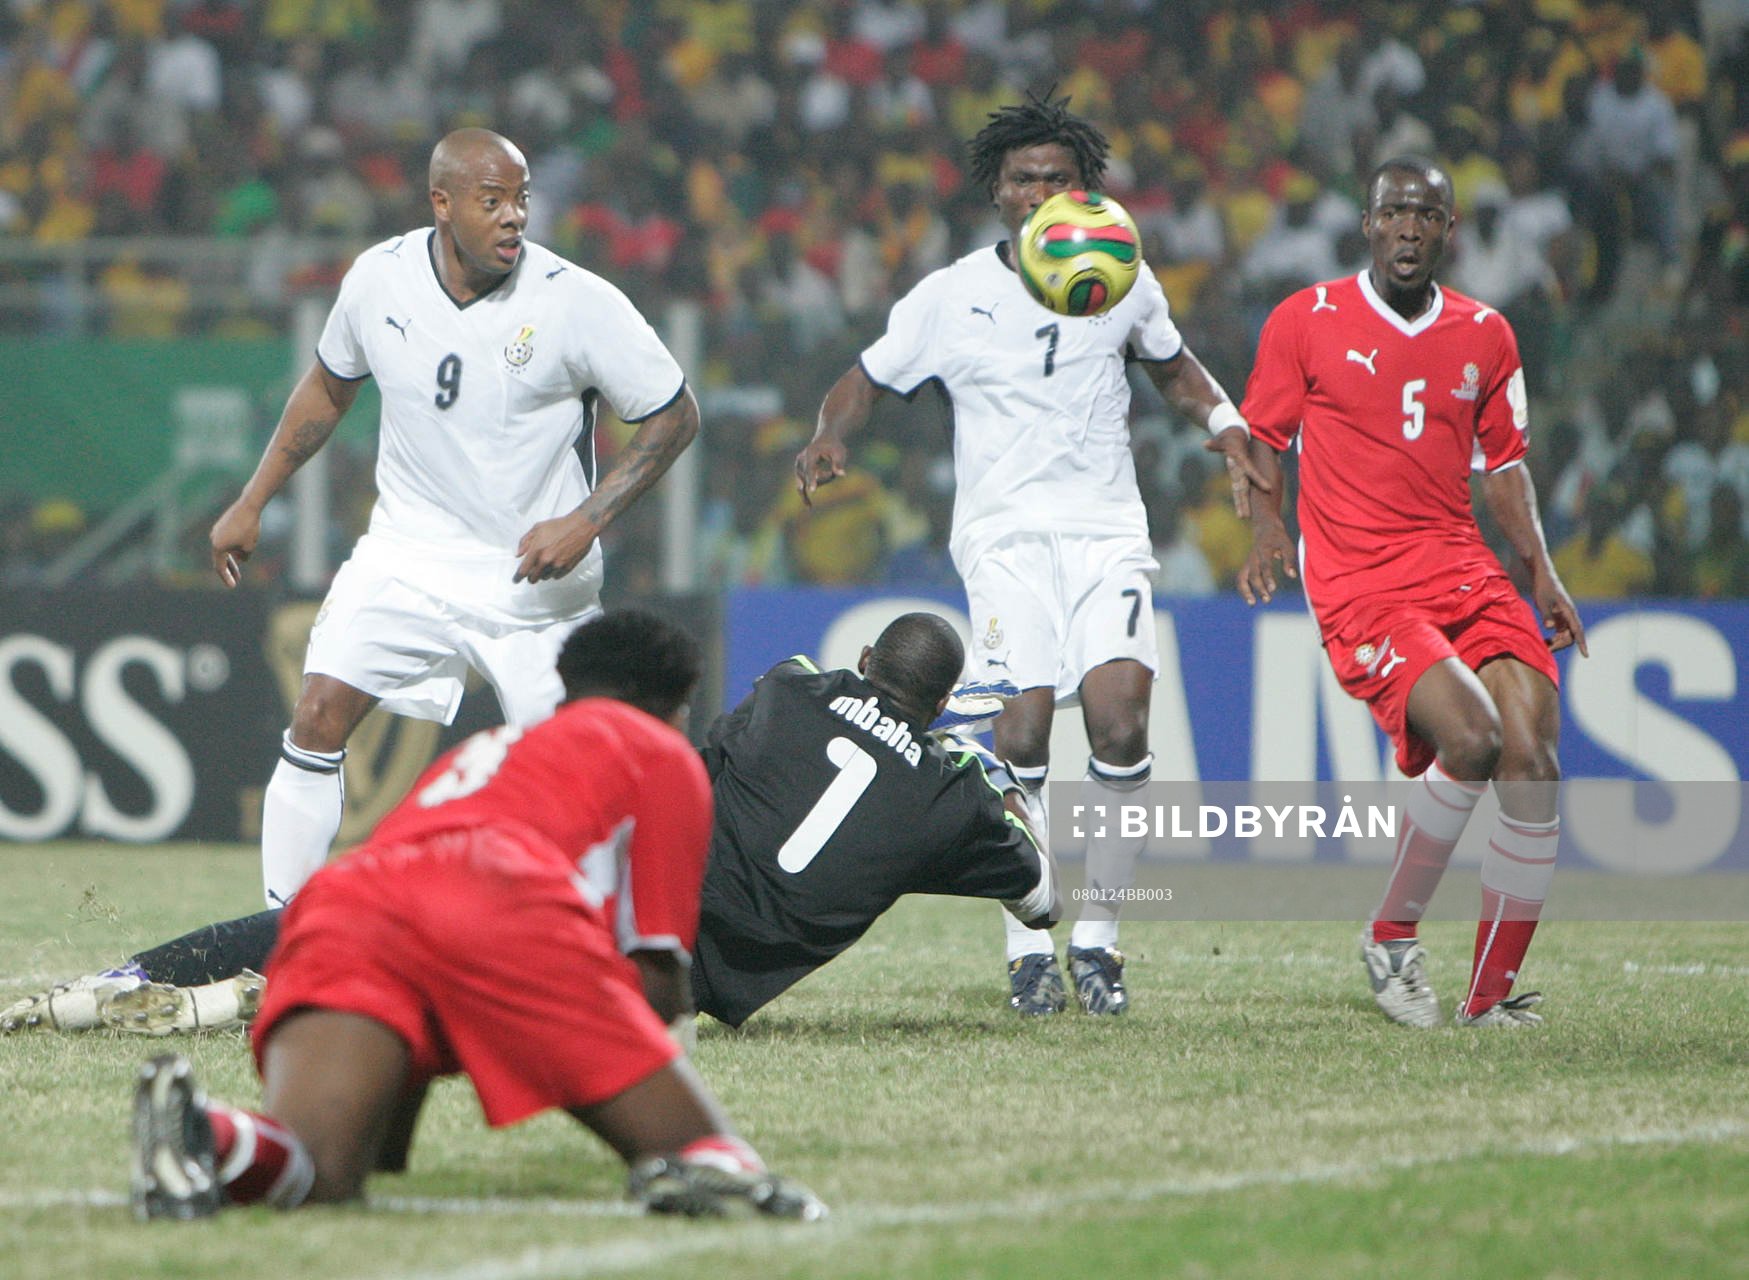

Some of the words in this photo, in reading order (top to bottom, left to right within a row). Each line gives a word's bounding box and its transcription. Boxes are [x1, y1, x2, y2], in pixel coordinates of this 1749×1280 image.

[1034, 322, 1060, 378] 7
[435, 353, 462, 411] 9
[1402, 379, 1427, 441] 5
[1121, 588, 1142, 638] 7
[828, 695, 923, 769] mbaha
